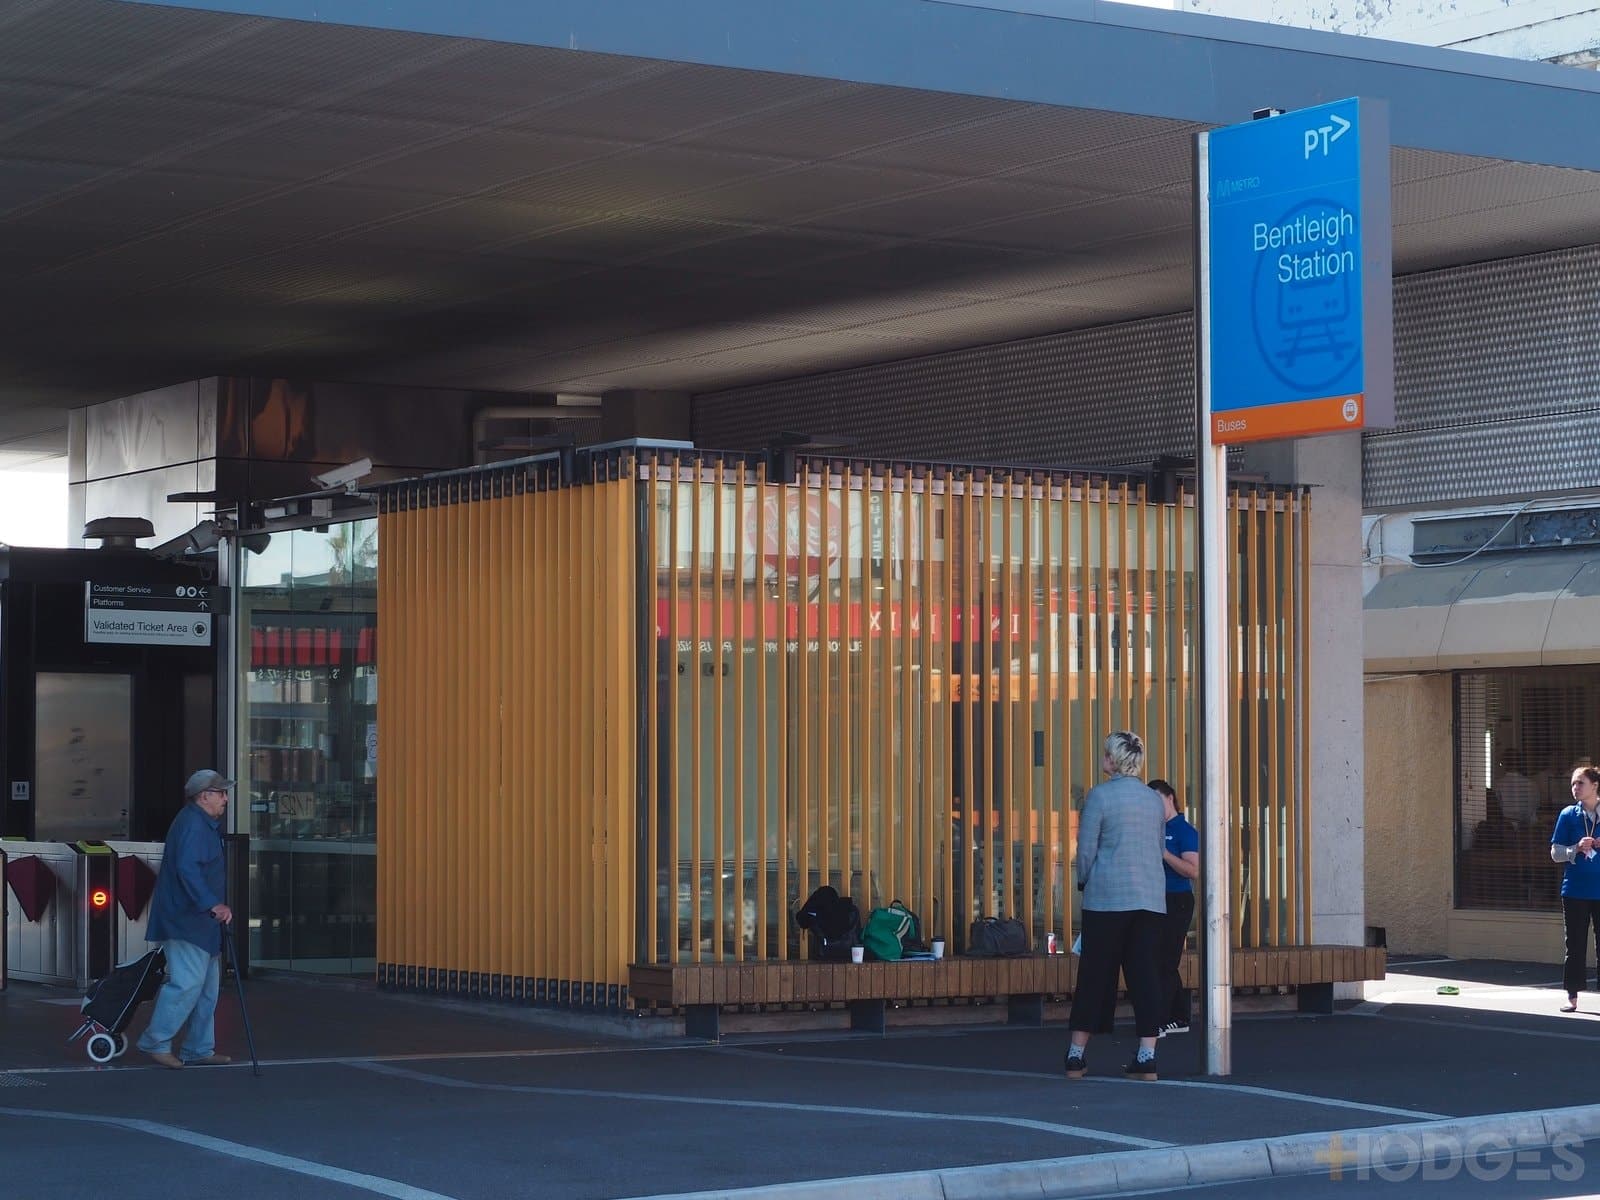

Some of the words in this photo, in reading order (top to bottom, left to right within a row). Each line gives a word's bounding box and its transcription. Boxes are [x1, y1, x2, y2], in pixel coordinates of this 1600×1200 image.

[1253, 208, 1353, 252] Bentleigh
[1277, 249, 1354, 284] Station
[1217, 418, 1247, 433] Buses
[93, 584, 126, 593] Customer
[126, 586, 152, 594] Service
[93, 599, 125, 607] Platforms
[93, 620, 135, 631] Validated
[137, 622, 164, 632] Ticket
[167, 623, 188, 633] Area
